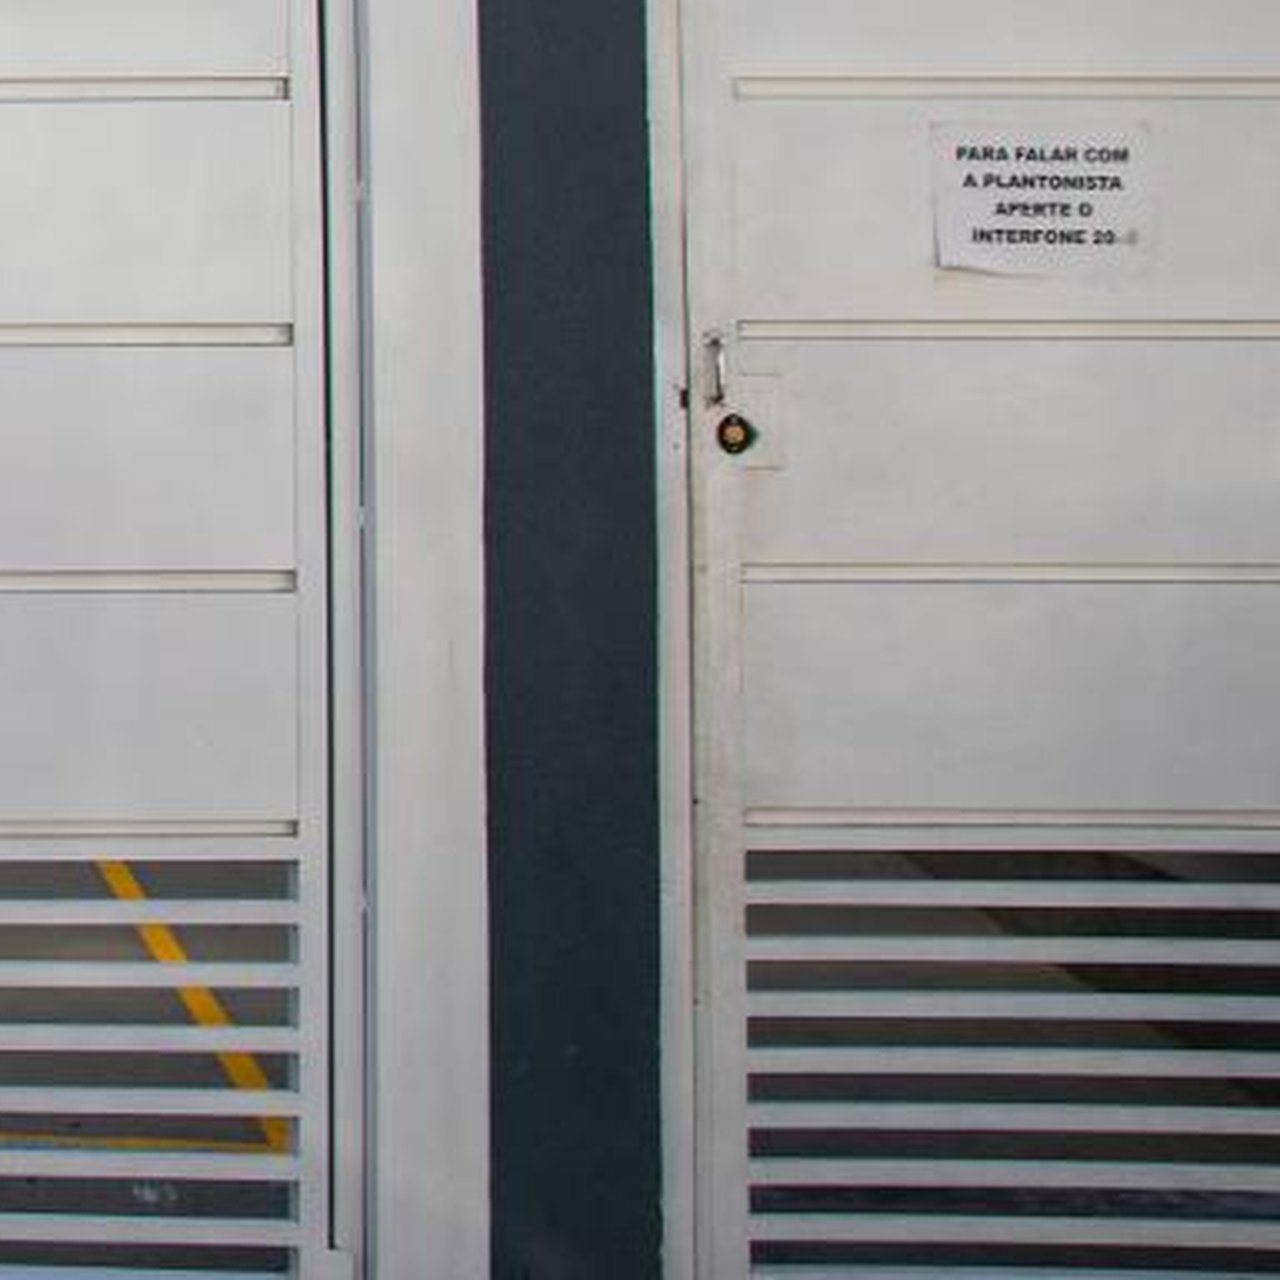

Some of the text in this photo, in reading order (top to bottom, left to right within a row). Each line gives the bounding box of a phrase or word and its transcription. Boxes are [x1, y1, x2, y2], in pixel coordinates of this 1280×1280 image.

[955, 146, 1130, 163] PARA FALAR COM
[963, 173, 1124, 192] A PLANTONISTA
[995, 202, 1094, 218] APERTE O
[972, 228, 1087, 246] INTERFONE
